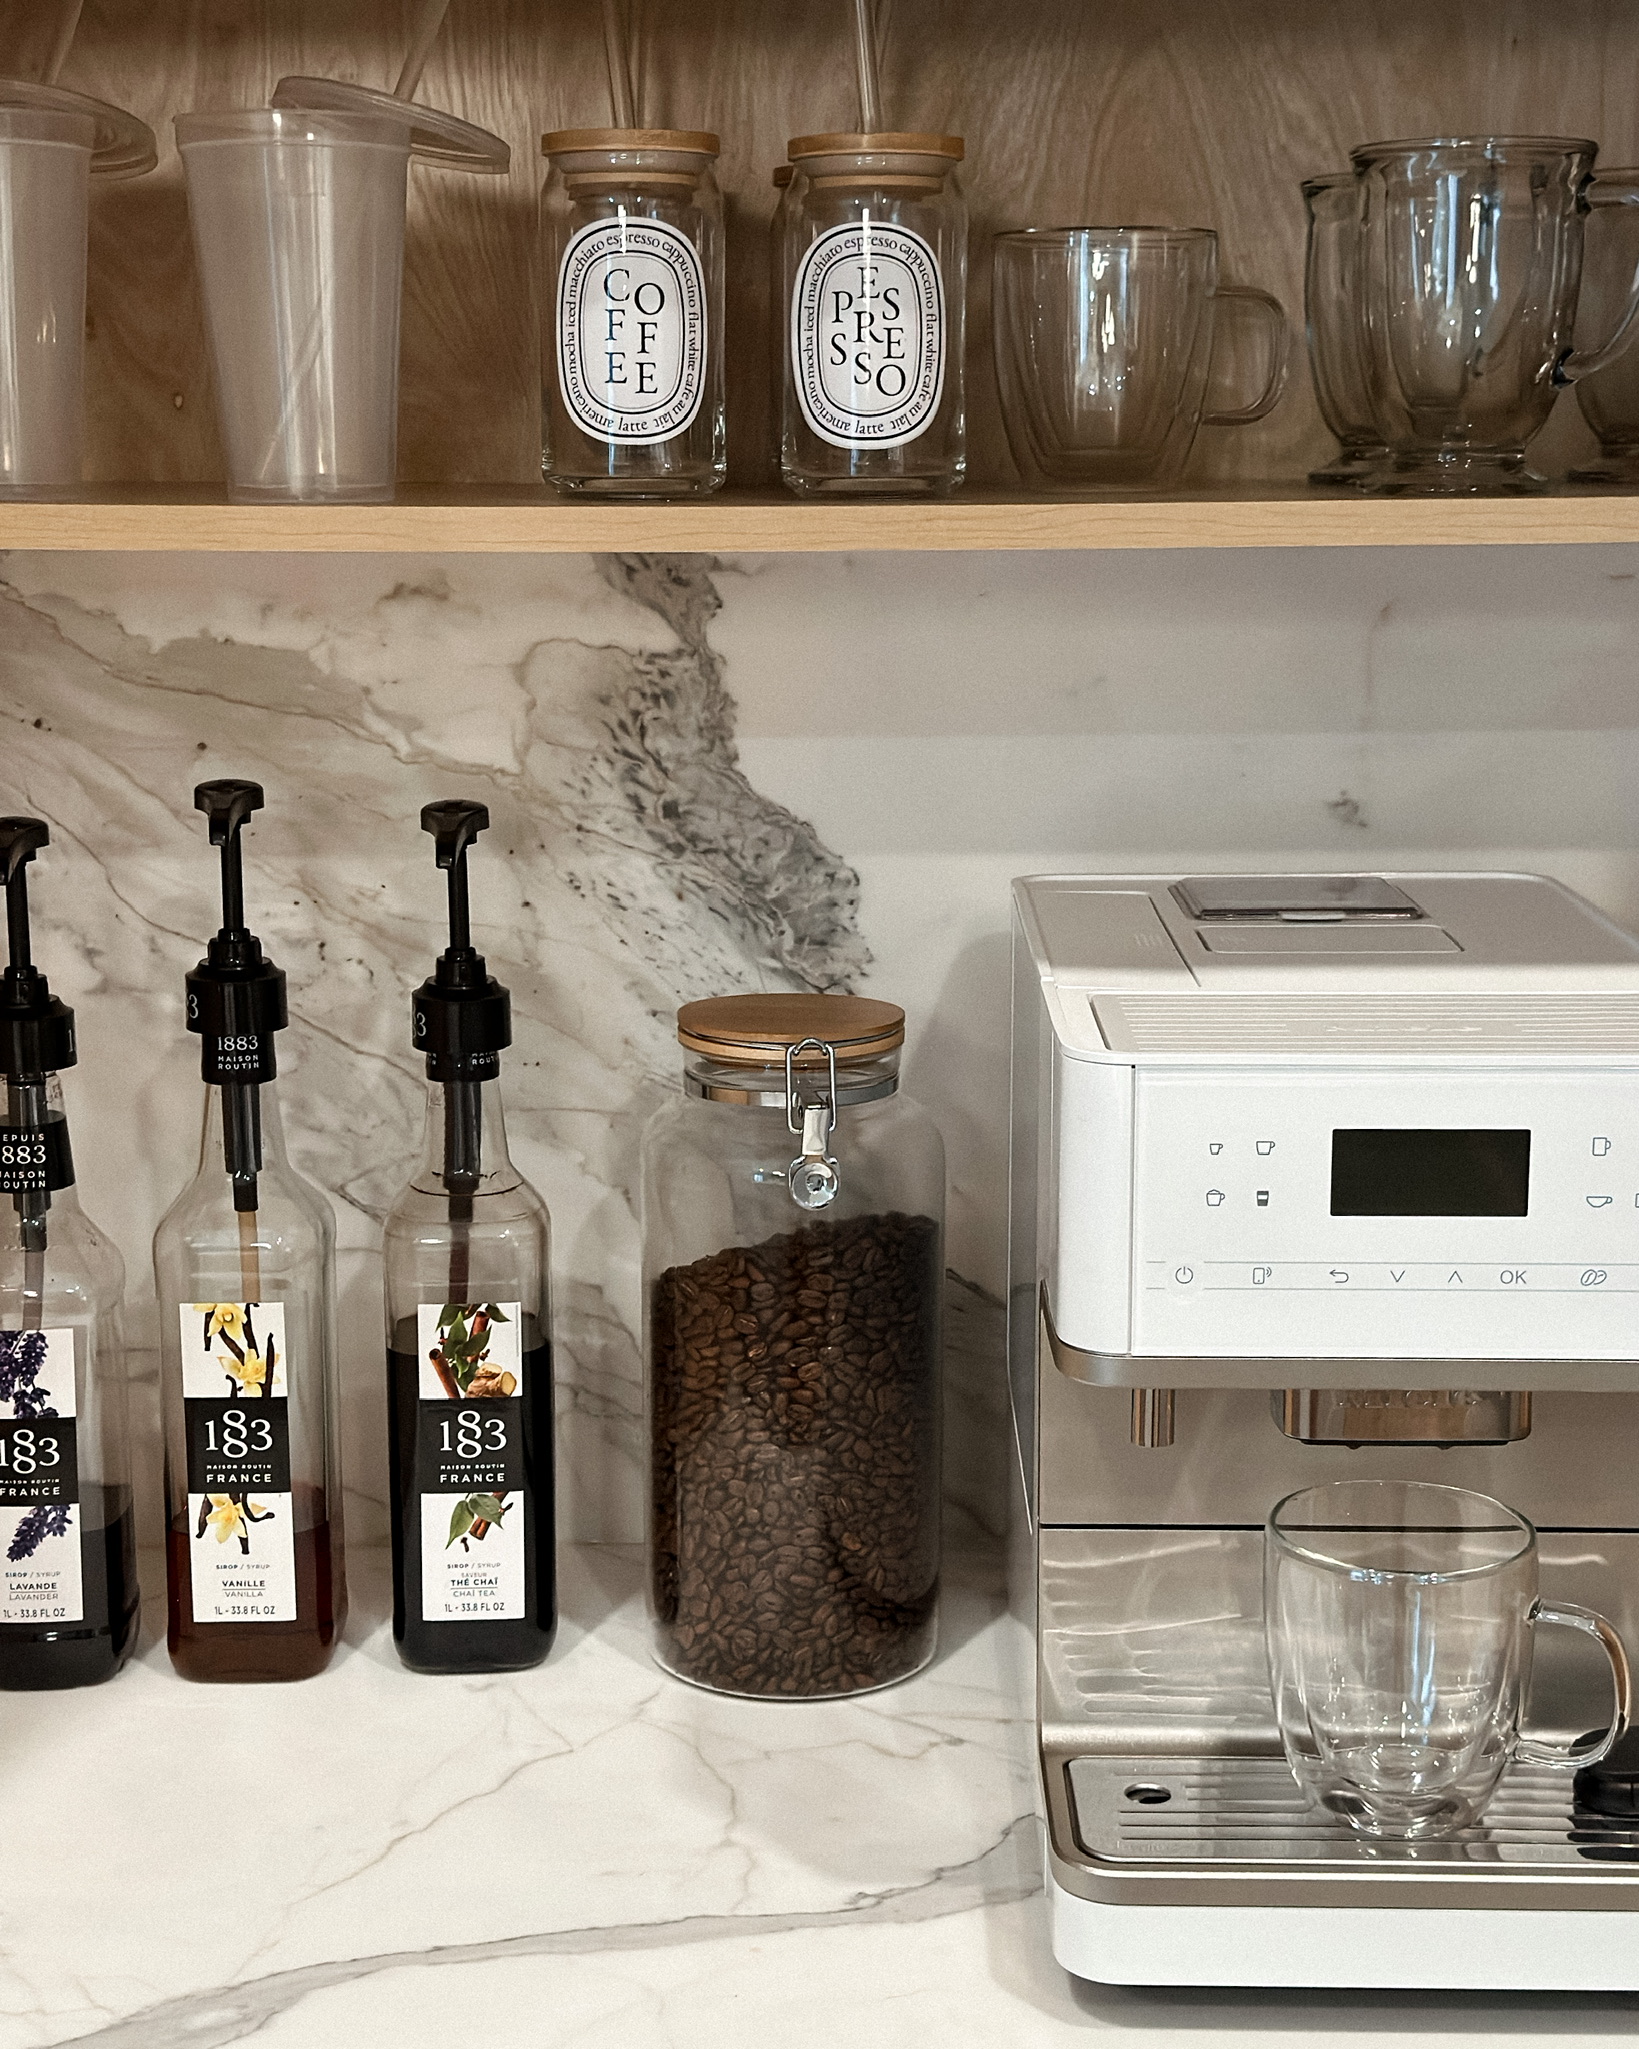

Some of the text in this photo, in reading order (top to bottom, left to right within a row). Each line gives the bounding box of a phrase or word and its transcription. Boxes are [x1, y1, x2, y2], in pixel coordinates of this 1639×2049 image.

[606, 234, 660, 248] espresso
[570, 240, 605, 298] macchiato
[662, 241, 696, 308] cappuccino
[808, 244, 843, 302] macchiato
[899, 243, 934, 309] cappuccino
[565, 301, 576, 327] iced
[804, 305, 815, 332] iced
[688, 312, 699, 335] flat
[926, 313, 937, 337] flat
[565, 332, 577, 374] mocha
[687, 337, 699, 371] white
[803, 336, 814, 379] mocha
[925, 338, 937, 373] white
[570, 376, 614, 428] americano
[672, 400, 685, 415] au
[808, 381, 851, 431] americano
[909, 401, 922, 416] au
[618, 416, 648, 431] latte
[653, 412, 675, 428] lait
[854, 420, 884, 435] latte
[890, 413, 912, 430] lait
[217, 1035, 259, 1051] 1883
[217, 1054, 259, 1062] MAISON
[217, 1061, 260, 1070] ROUTIN
[2, 1133, 45, 1142] EPUIS
[1, 1144, 47, 1165] 883
[0, 1170, 46, 1179] AISON
[0, 1180, 46, 1189] OUTIN
[1500, 1269, 1527, 1285] OK
[206, 1473, 272, 1483] FRANCE
[439, 1472, 505, 1483] FRANCE
[0, 1486, 60, 1496] FRANCE
[9, 1582, 57, 1590] LAVANDE
[450, 1577, 470, 1586] THÉ
[478, 1589, 495, 1597] TEA
[3, 1609, 12, 1618] 1L
[20, 1608, 38, 1618] 33.8
[40, 1608, 51, 1617] FL
[52, 1607, 66, 1617] OZ
[214, 1605, 223, 1615] 1L
[230, 1605, 249, 1615] 33.8
[250, 1605, 261, 1615] FL
[263, 1605, 275, 1615] OZ
[444, 1603, 453, 1613] 1L
[461, 1602, 478, 1612] 33.8
[480, 1602, 491, 1612] FL
[492, 1602, 505, 1611] OZ
